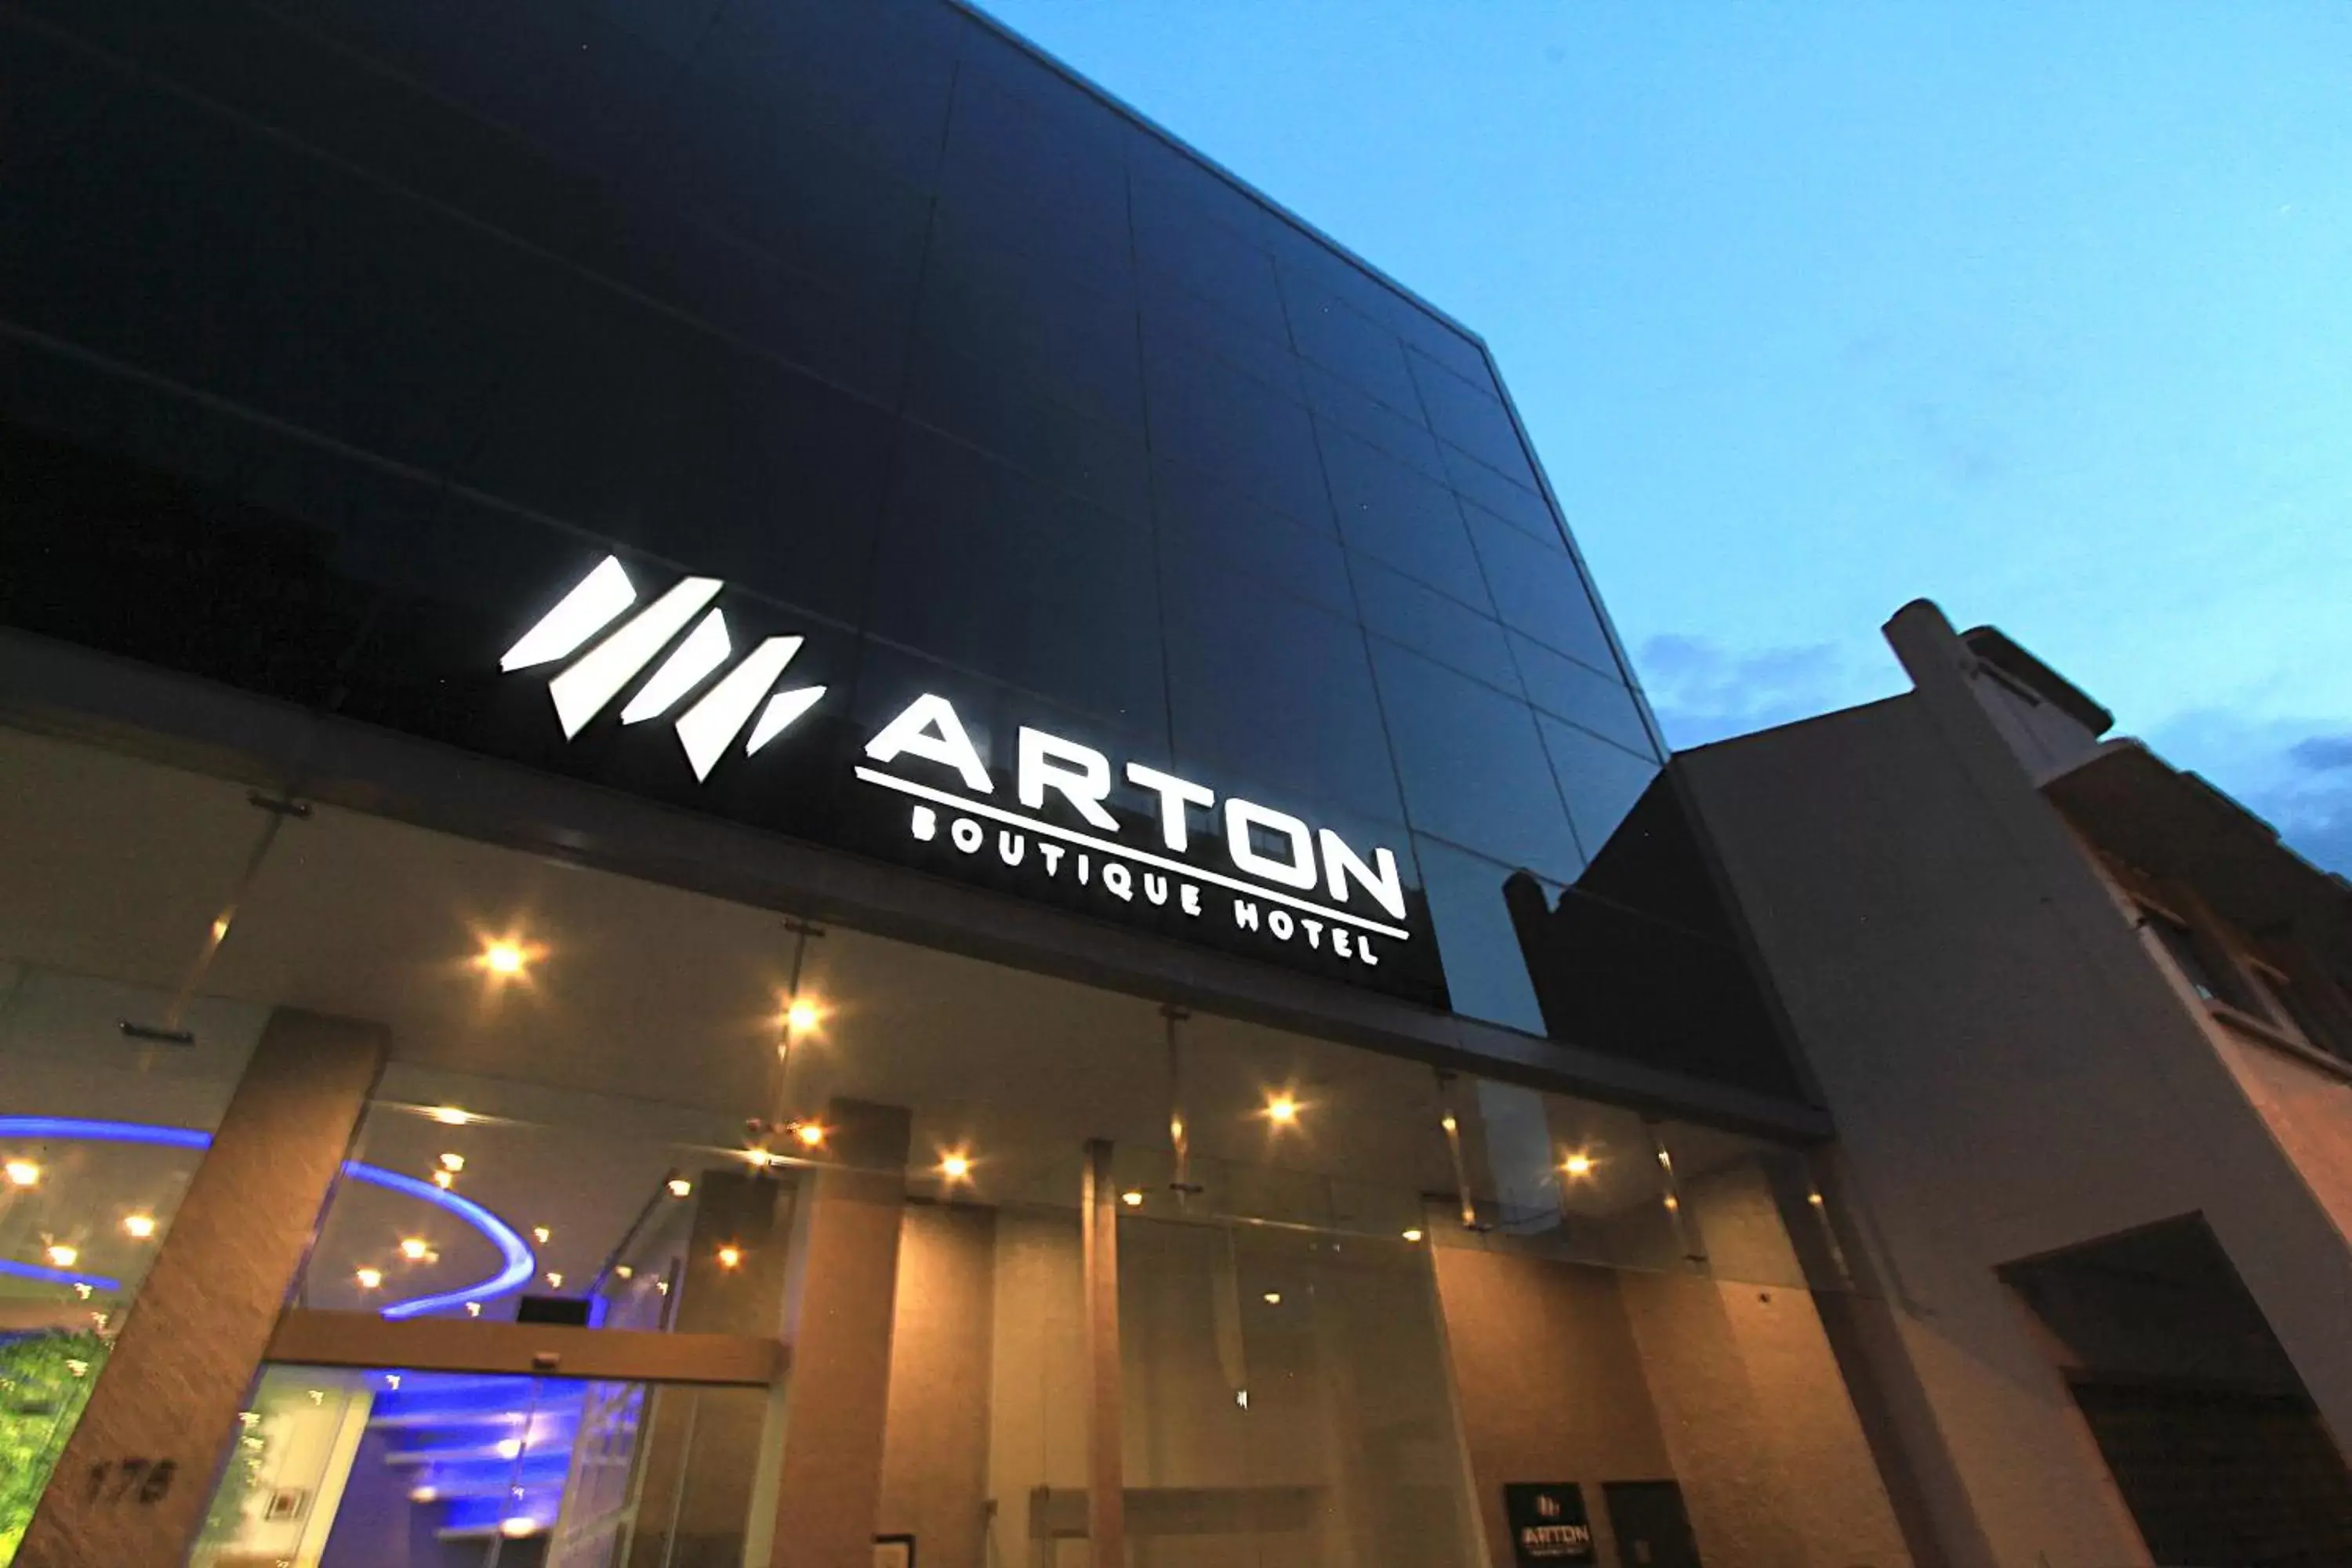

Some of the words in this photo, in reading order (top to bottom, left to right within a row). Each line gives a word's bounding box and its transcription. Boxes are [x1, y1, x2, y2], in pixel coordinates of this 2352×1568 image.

[865, 693, 1406, 920] ARTON
[910, 805, 1202, 916] BOUTIQUE
[1234, 899, 1379, 966] HOTEL
[1522, 1525, 1589, 1544] ARTON
